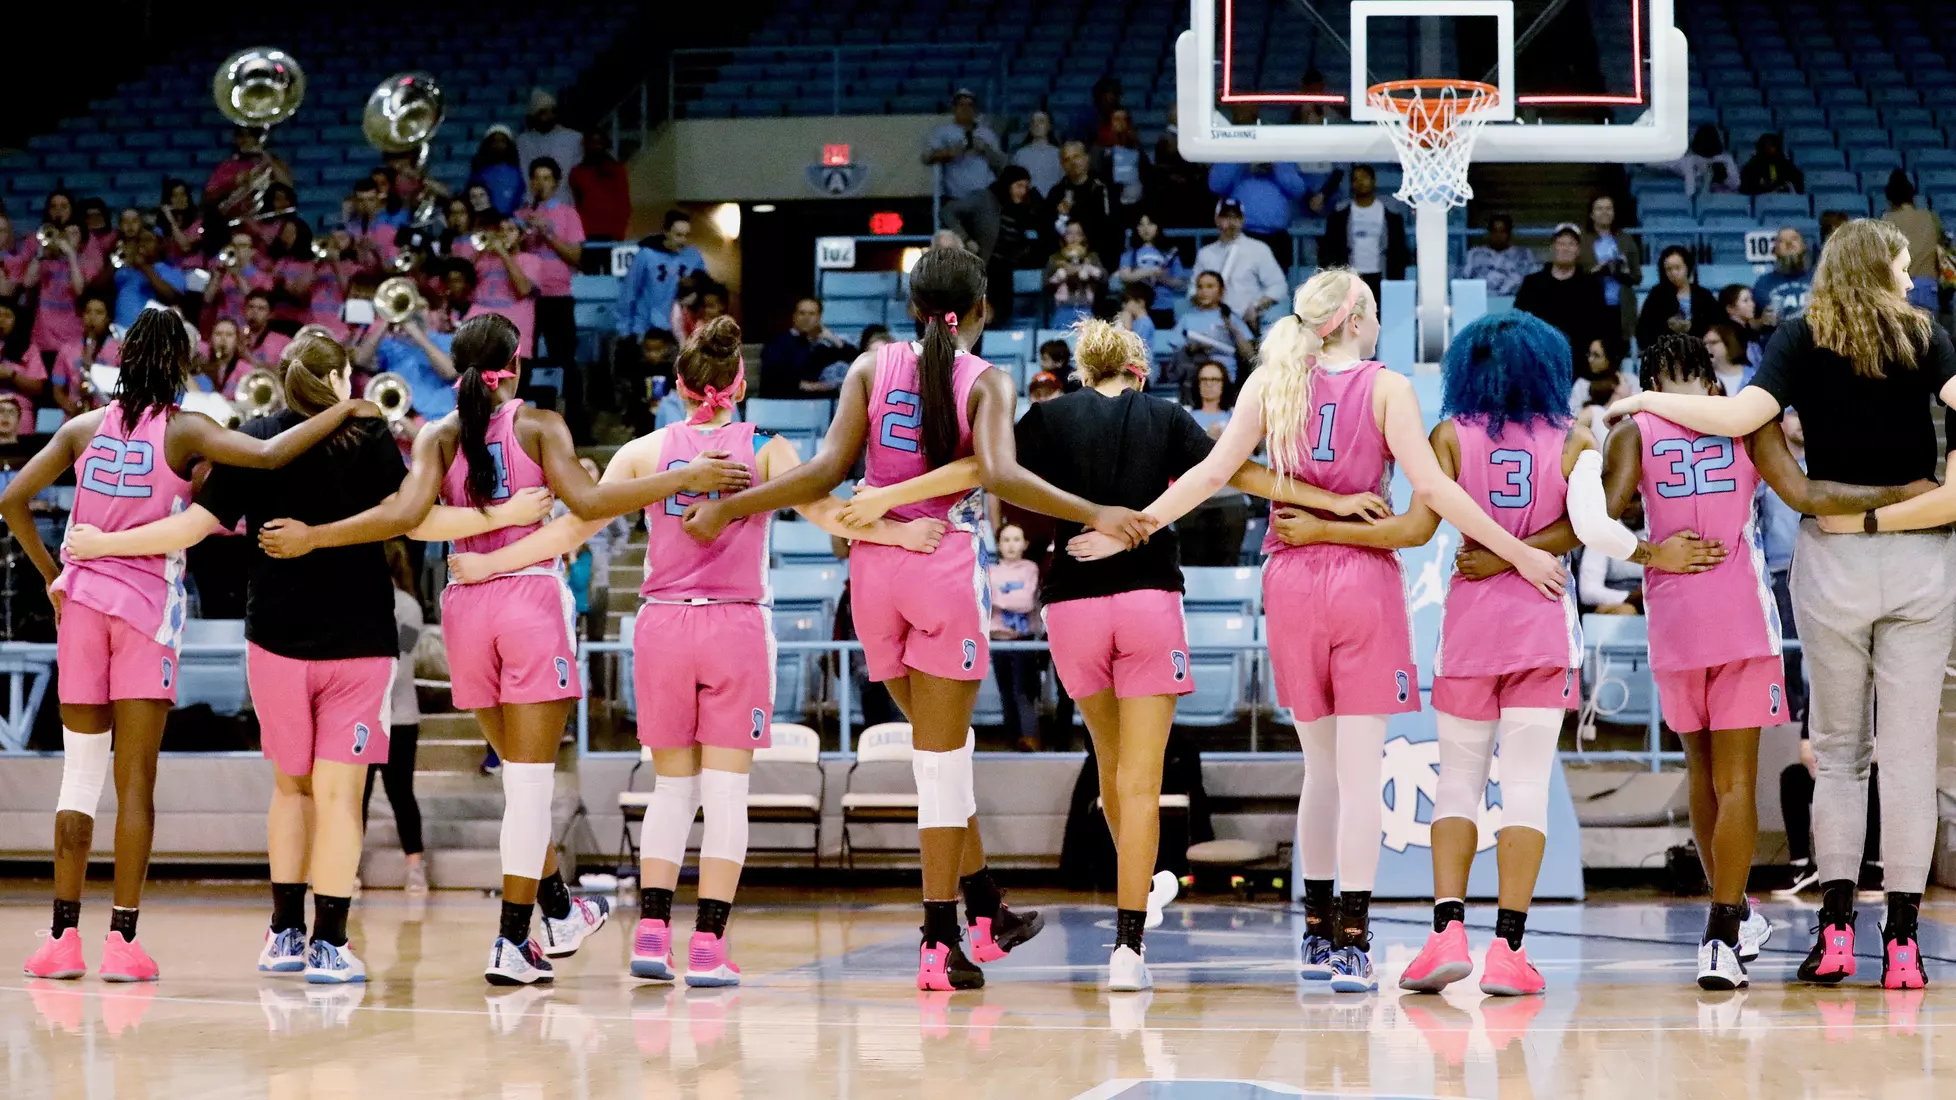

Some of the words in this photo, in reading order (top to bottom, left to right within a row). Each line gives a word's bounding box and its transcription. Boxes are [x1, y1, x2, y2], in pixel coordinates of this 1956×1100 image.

[618, 252, 634, 269] 10
[822, 246, 850, 261] 102
[880, 389, 923, 453] 2
[1312, 403, 1336, 462] 1
[82, 434, 154, 498] 22
[1489, 448, 1532, 508] 3
[1652, 435, 1736, 498] 32
